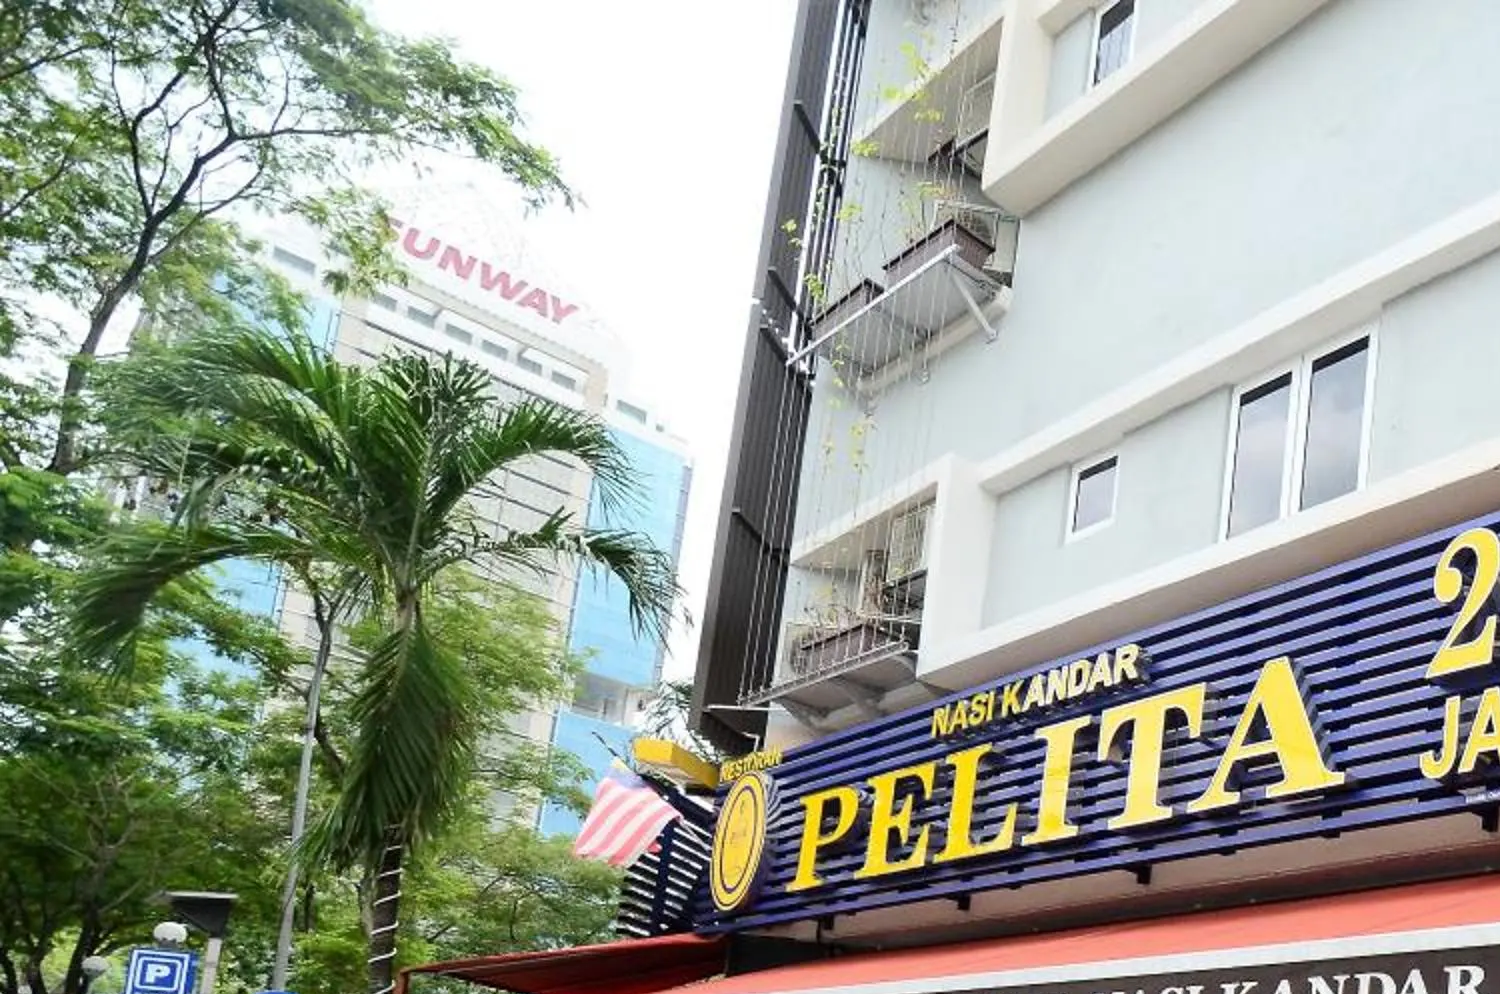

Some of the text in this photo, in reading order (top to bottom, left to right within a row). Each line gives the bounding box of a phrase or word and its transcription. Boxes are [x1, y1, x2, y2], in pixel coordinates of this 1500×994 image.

[931, 643, 1145, 740] NASI KANDAR
[785, 655, 1346, 893] PELITA
[145, 963, 171, 984] P
